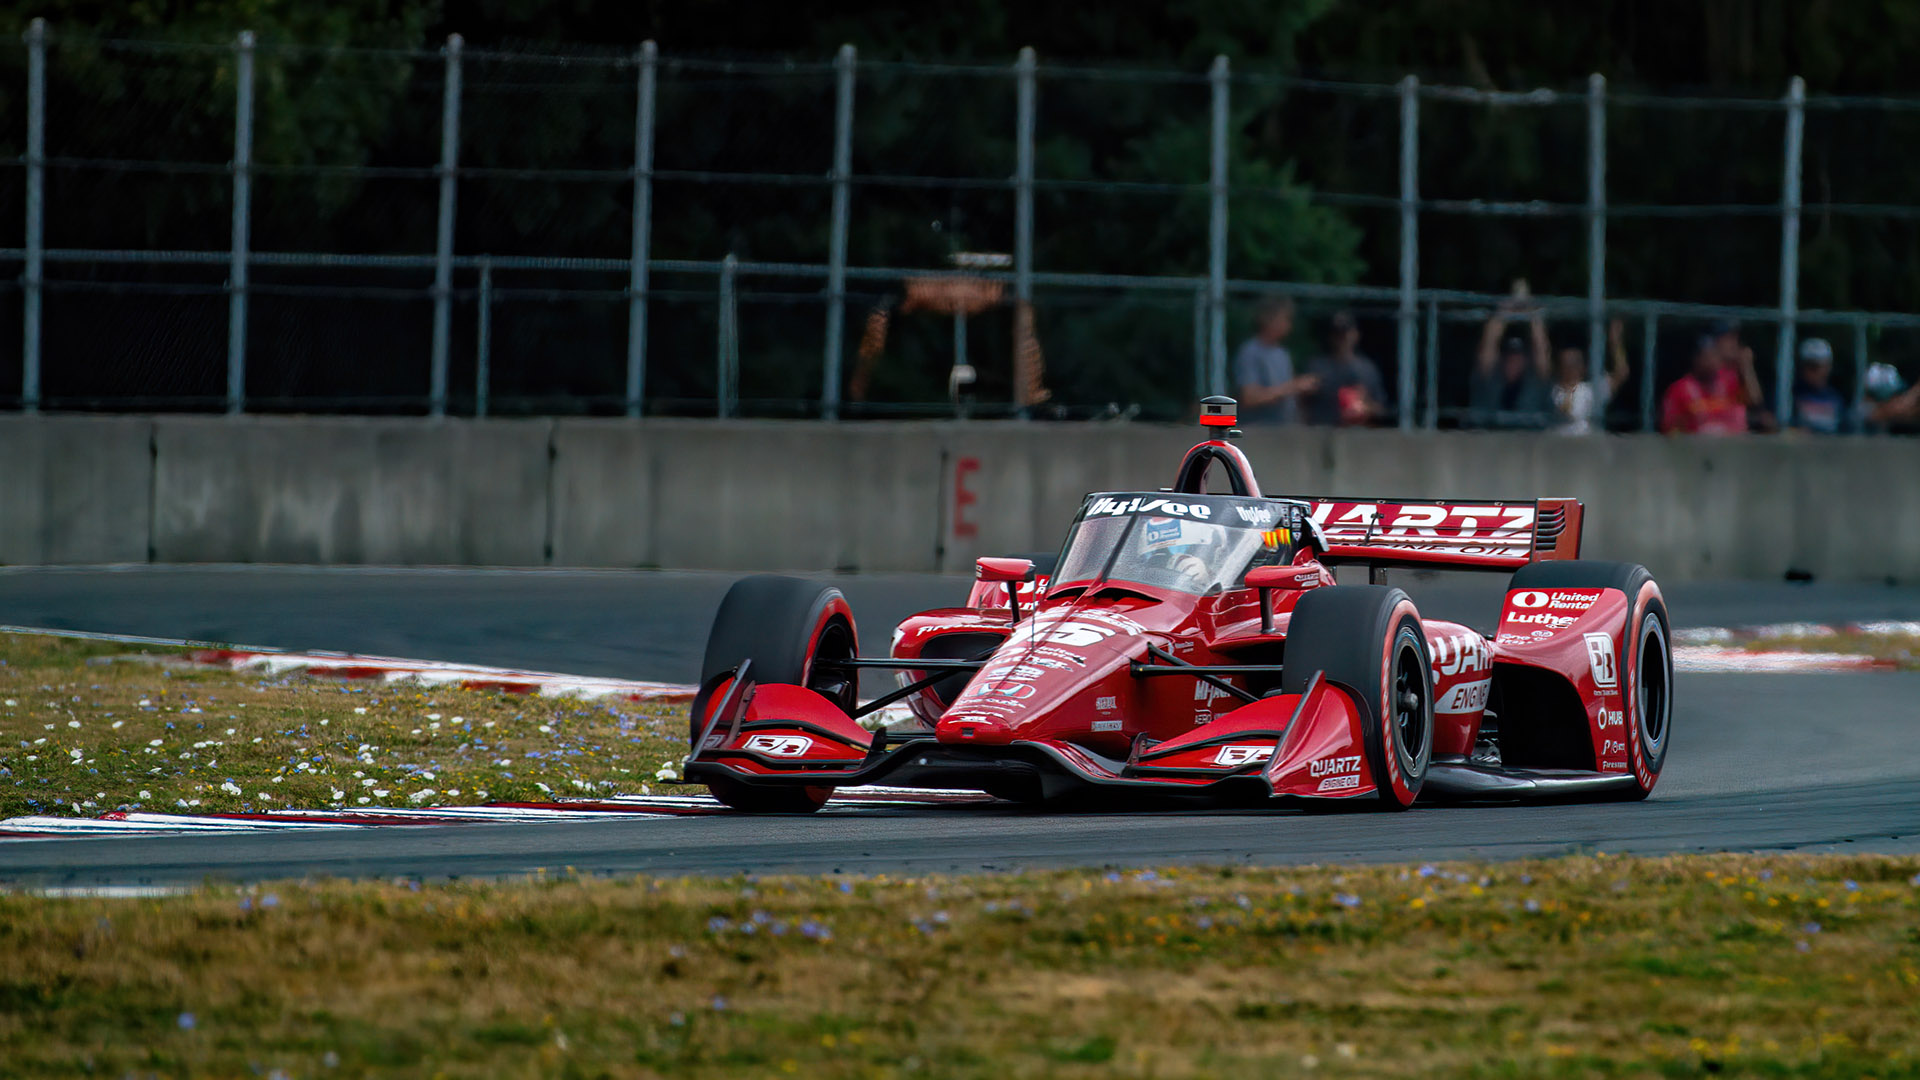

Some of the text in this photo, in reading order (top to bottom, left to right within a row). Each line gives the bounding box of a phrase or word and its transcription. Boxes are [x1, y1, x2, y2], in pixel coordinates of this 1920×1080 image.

[954, 456, 981, 537] E
[1311, 503, 1536, 539] ARTZ
[1548, 601, 1595, 610] Rental
[1551, 592, 1600, 602] United
[1451, 684, 1488, 710] ENGINE
[1608, 710, 1624, 726] HUB
[1310, 755, 1361, 778] QUARTZ
